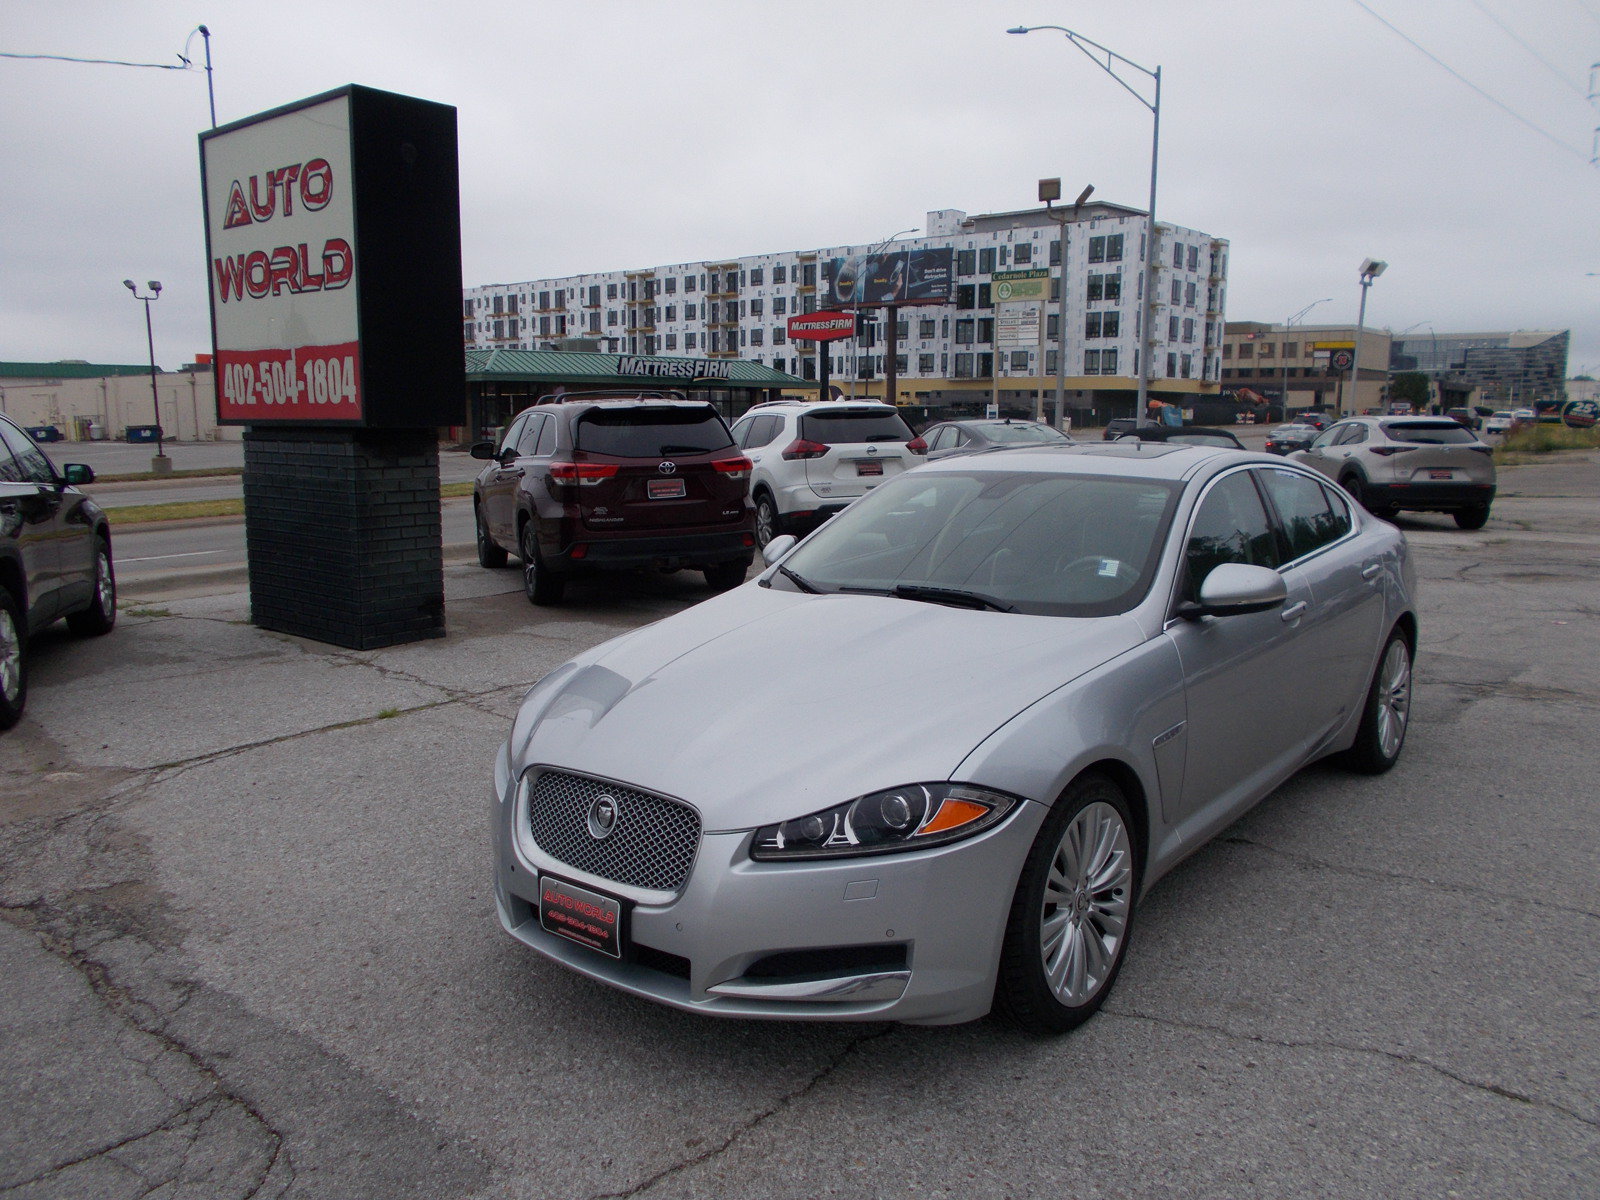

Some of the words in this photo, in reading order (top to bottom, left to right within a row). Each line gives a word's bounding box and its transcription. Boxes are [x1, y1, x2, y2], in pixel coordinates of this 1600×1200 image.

[223, 158, 333, 230] AUTO
[215, 238, 353, 303] WORLD
[1028, 269, 1048, 278] Plaza
[224, 355, 356, 405] 402-504-1804
[543, 889, 574, 908] AUTO
[574, 900, 615, 923] WORLD
